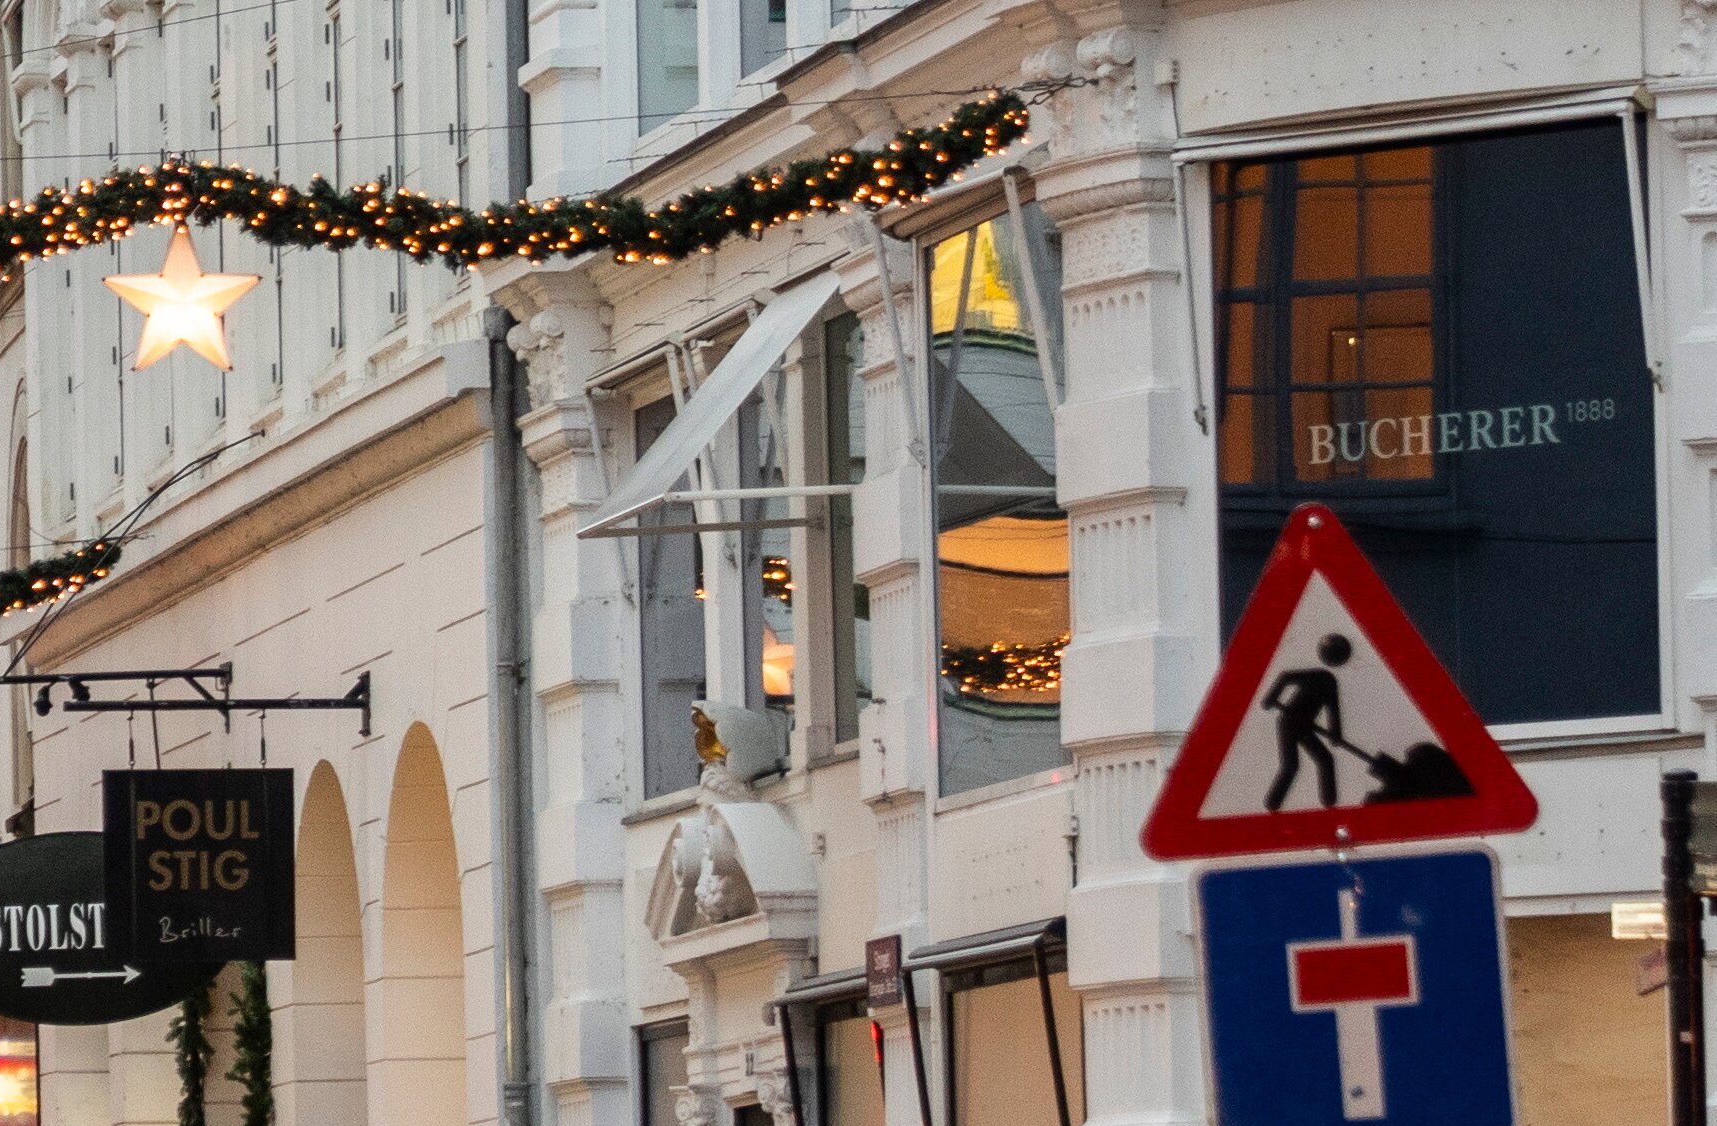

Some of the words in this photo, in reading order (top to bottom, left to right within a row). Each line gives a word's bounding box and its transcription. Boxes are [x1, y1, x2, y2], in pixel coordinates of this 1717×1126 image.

[1309, 404, 1561, 464] BUCHERER
[1567, 399, 1615, 422] 1888
[136, 799, 260, 841] POUL
[148, 849, 250, 892] STIG
